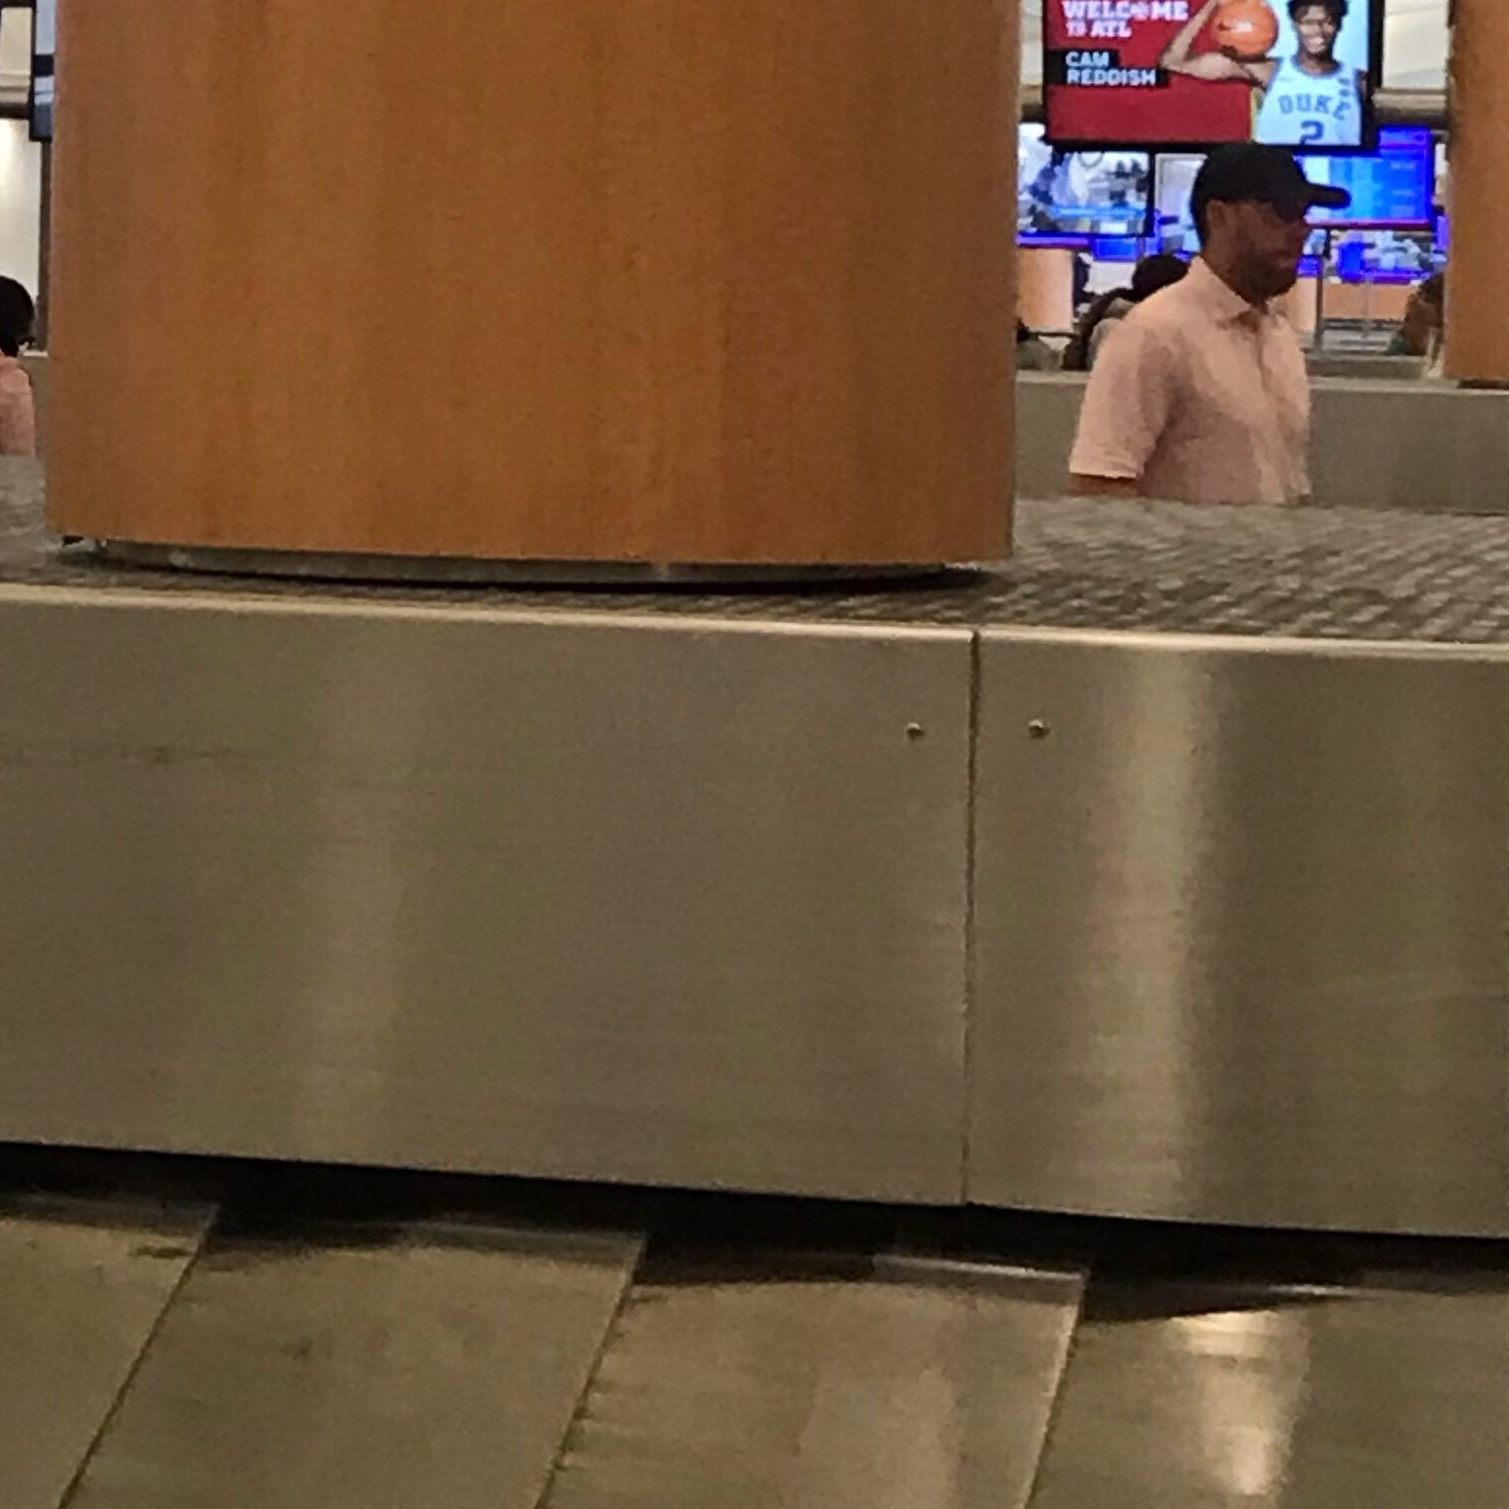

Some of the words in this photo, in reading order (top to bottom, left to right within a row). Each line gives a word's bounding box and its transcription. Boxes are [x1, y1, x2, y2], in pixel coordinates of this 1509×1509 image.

[1090, 21, 1132, 38] ATL
[1065, 51, 1109, 67] CAM
[1067, 69, 1156, 86] REDDISH
[1278, 93, 1351, 122] DUKE
[1300, 119, 1324, 145] 2
